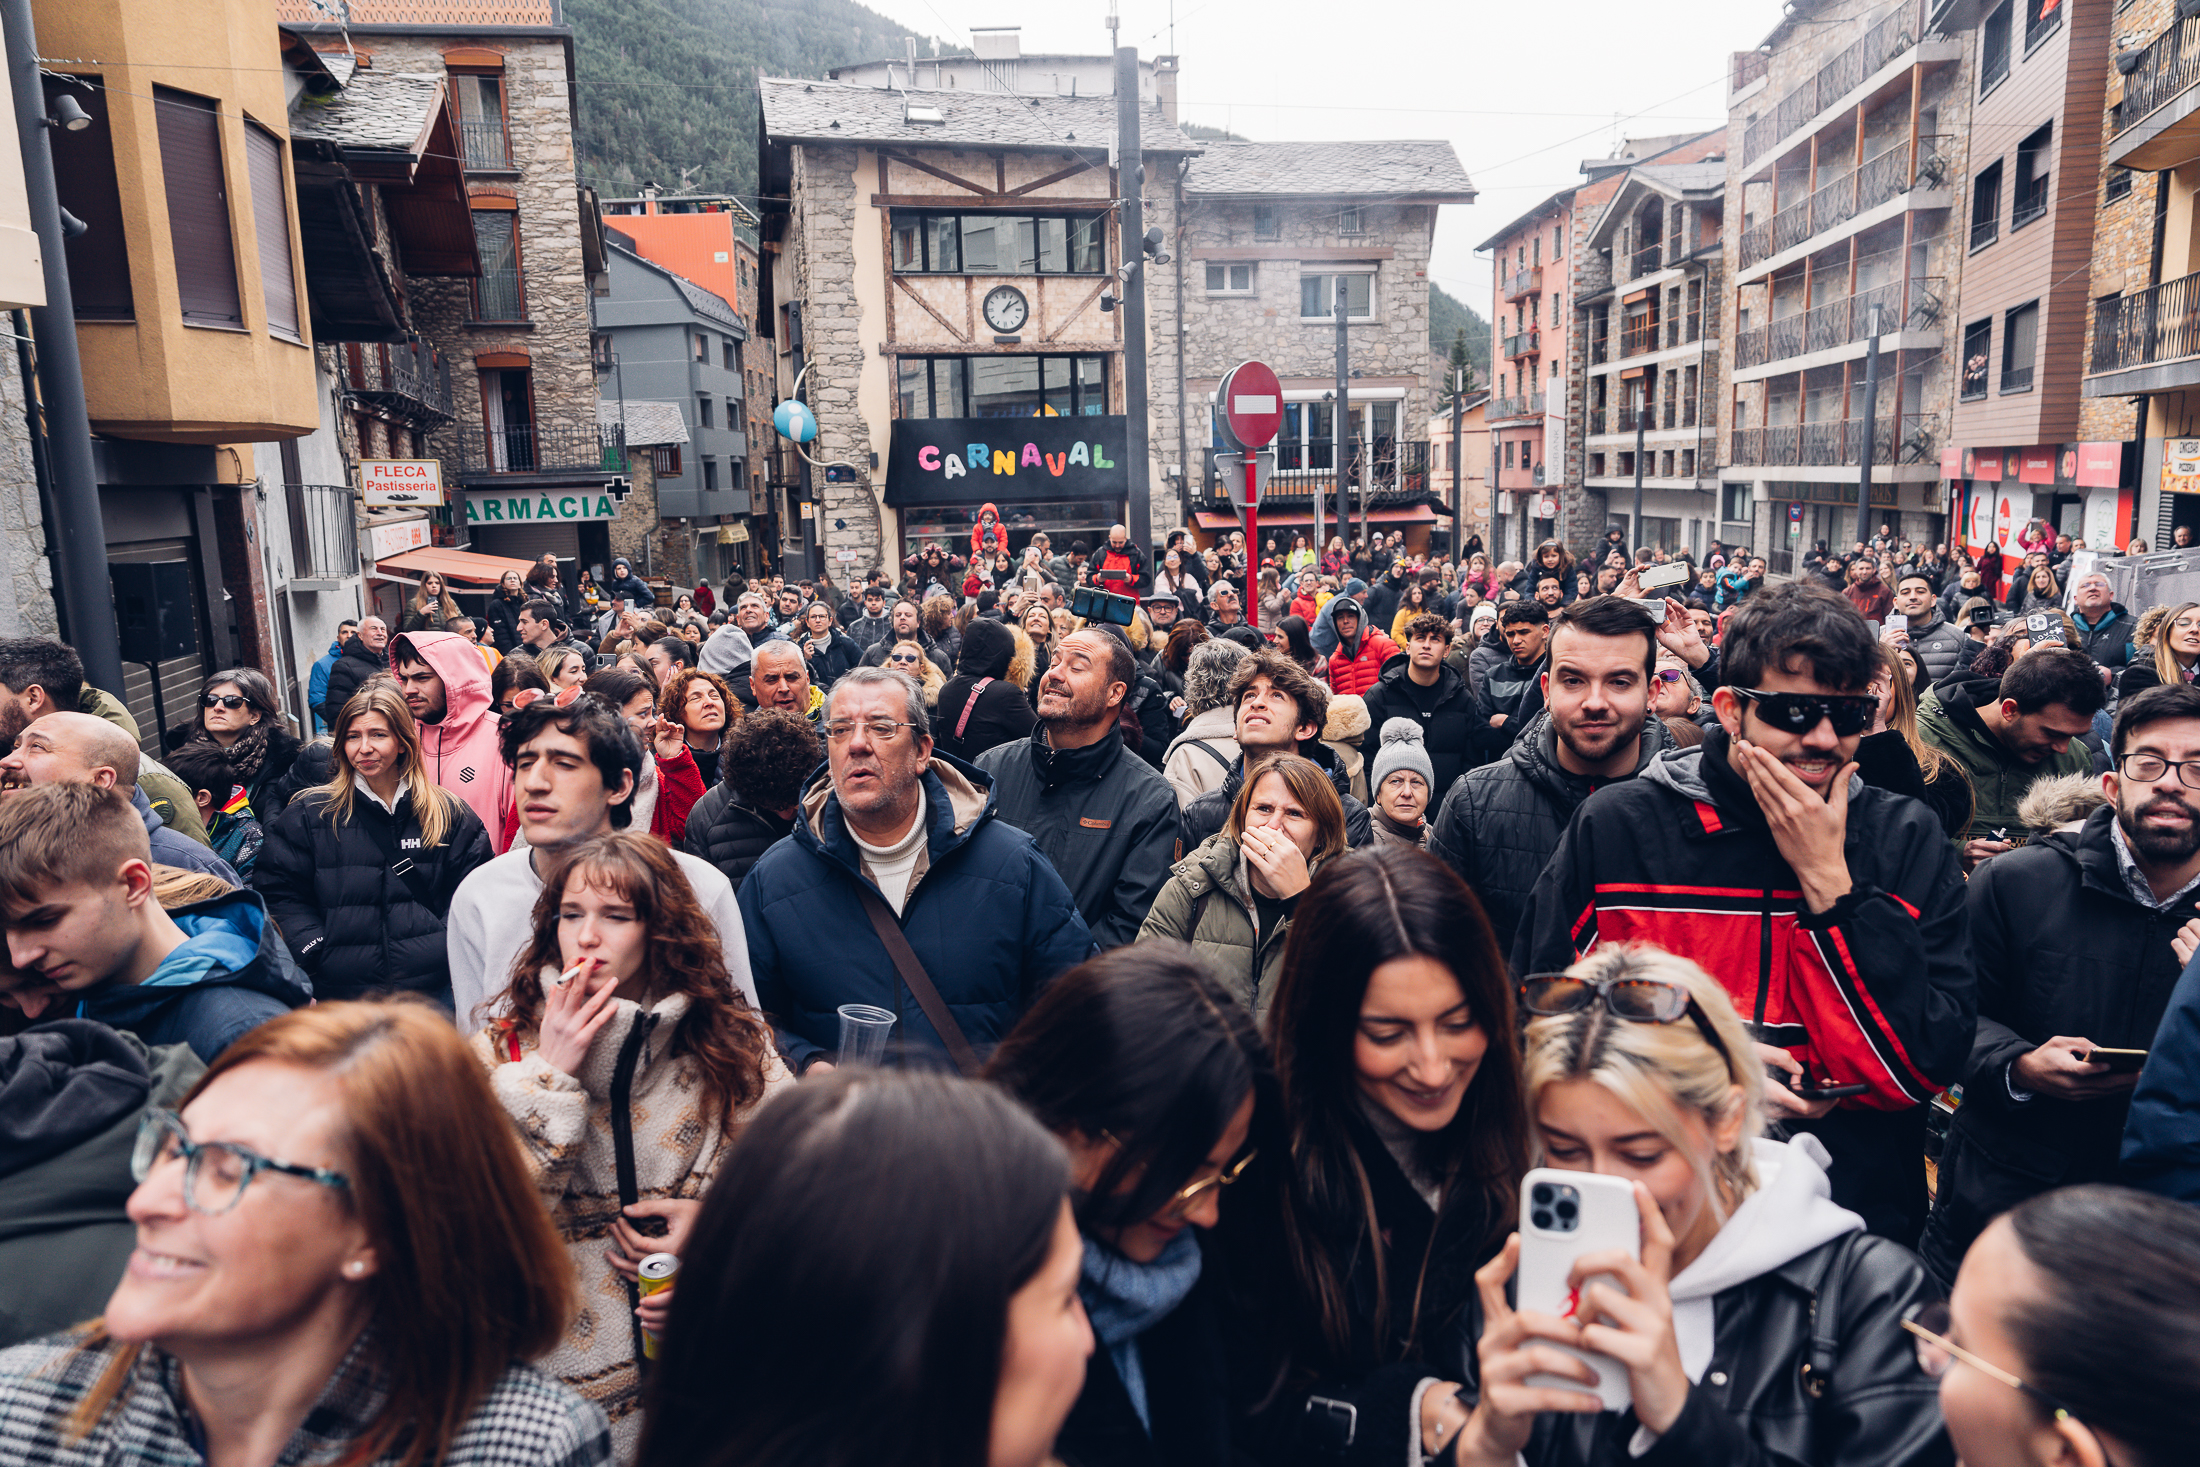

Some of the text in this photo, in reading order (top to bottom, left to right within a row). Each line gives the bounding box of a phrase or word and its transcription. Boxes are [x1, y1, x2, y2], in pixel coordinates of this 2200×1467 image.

[918, 441, 1115, 480] CARNAVAL
[1552, 429, 1560, 483] ANDBANK
[374, 466, 427, 478] FLECA
[366, 480, 437, 492] Pastisseria
[467, 492, 616, 522] ARMÀCIA
[401, 838, 421, 849] HH
